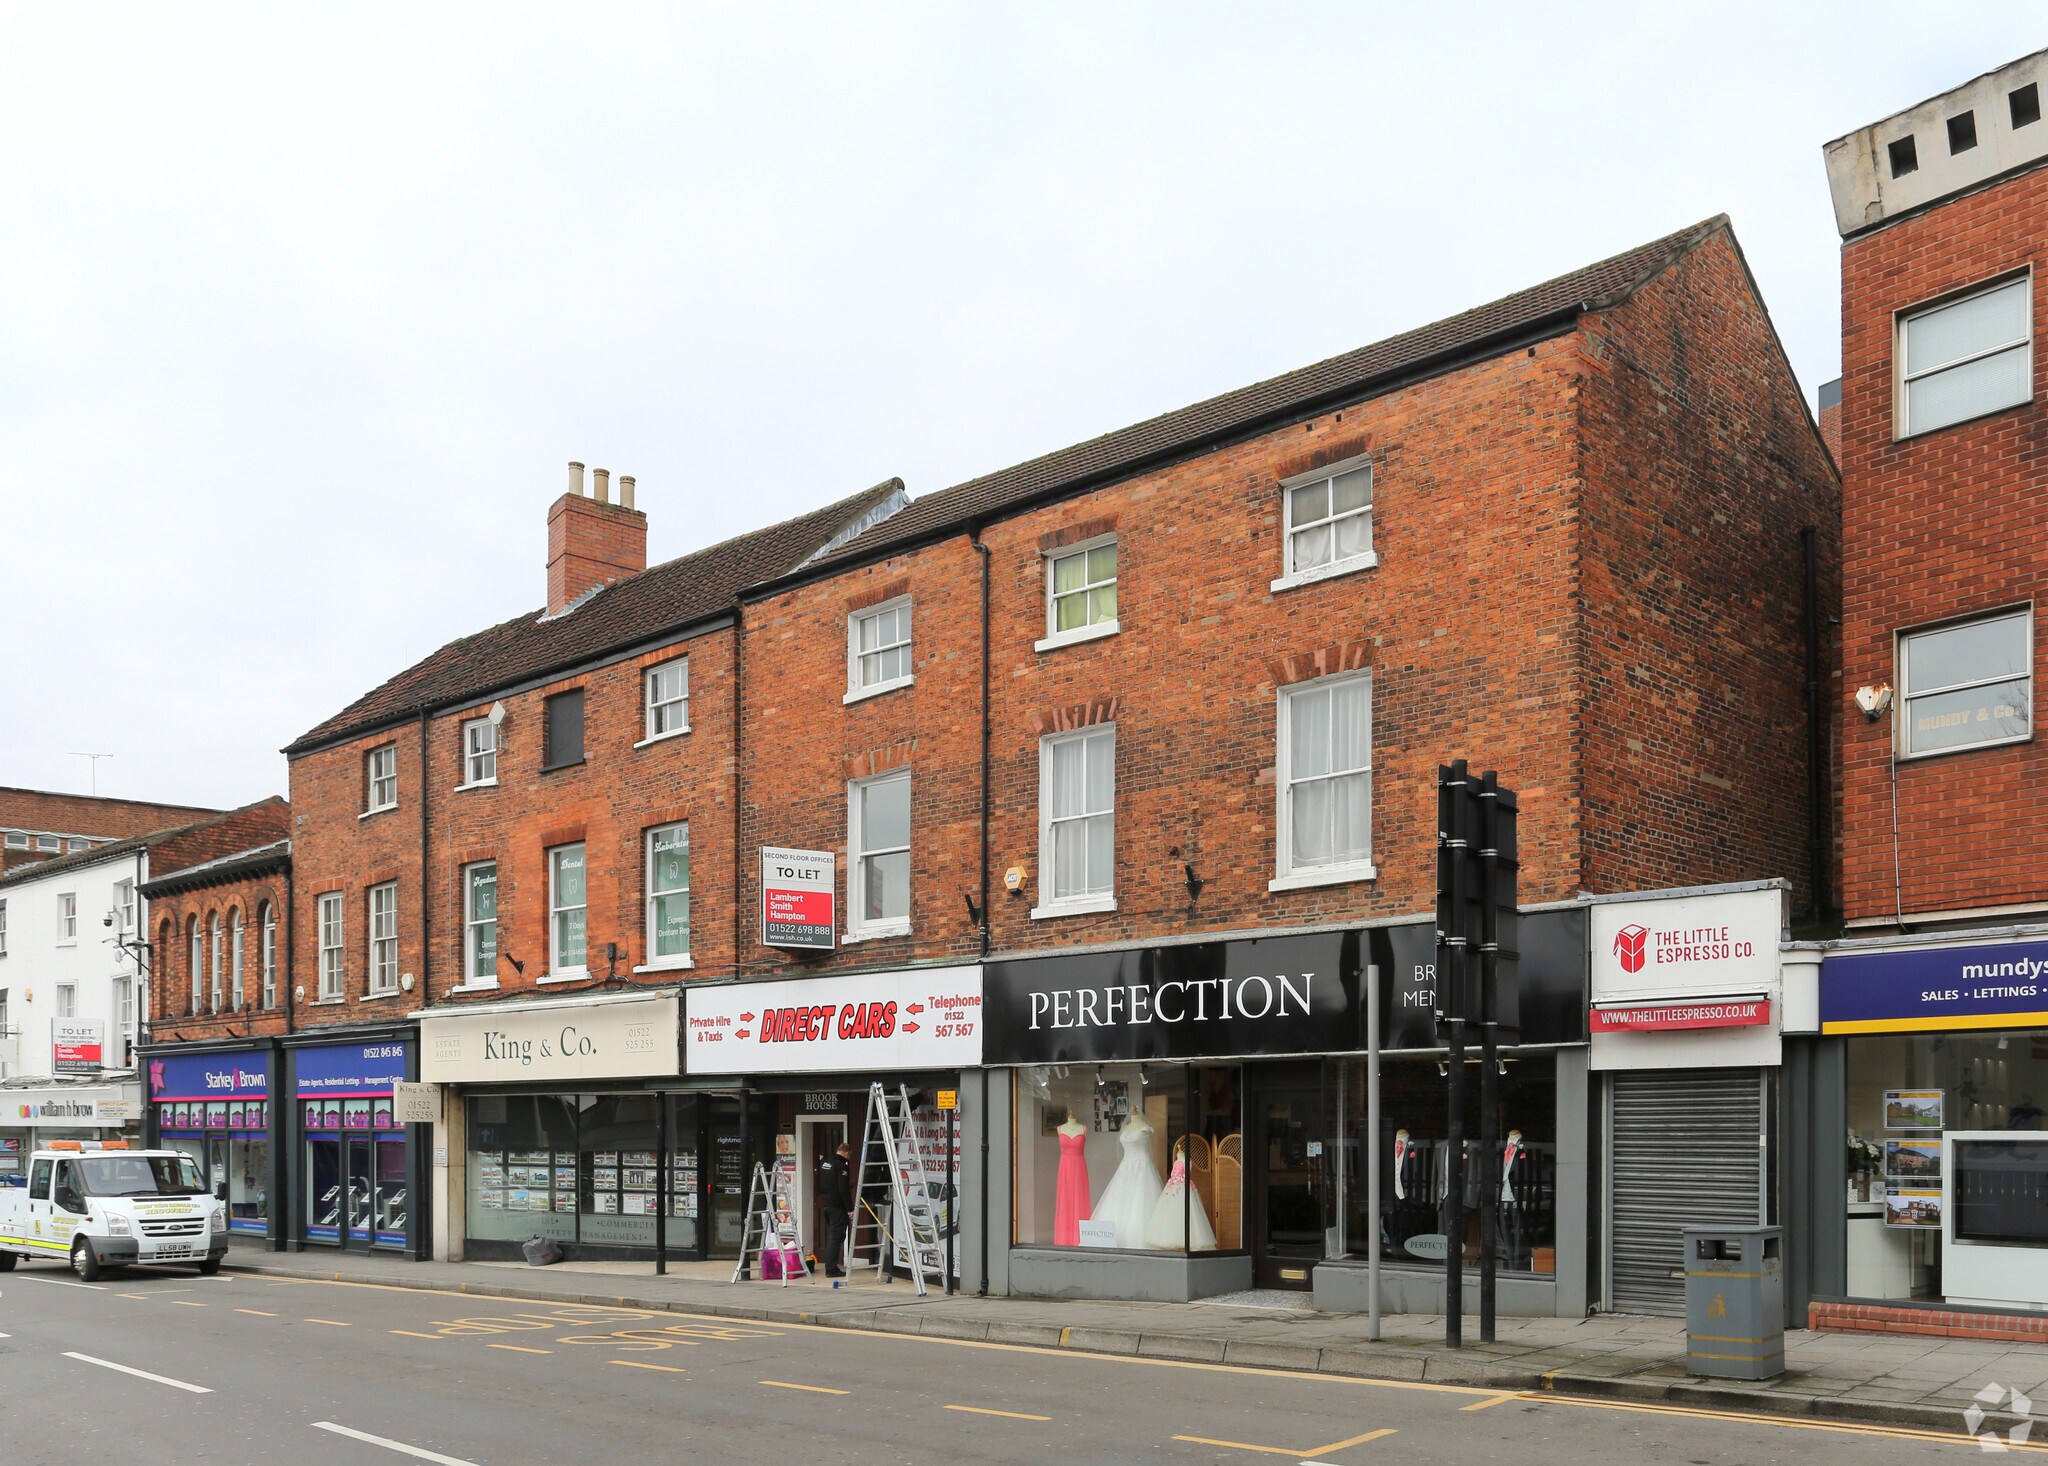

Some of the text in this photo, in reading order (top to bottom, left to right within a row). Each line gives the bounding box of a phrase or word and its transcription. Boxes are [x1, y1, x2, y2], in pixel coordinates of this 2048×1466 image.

[1919, 711, 1970, 731] MUNDY
[1977, 707, 1988, 721] &
[764, 852, 788, 860] SECOND
[789, 854, 809, 862] FLOOR
[776, 866, 820, 880] TO LET
[770, 892, 804, 902] Lambert
[770, 901, 793, 911] Smith
[667, 916, 687, 924] Express
[770, 911, 806, 921] Hampton
[680, 927, 690, 936] Rep
[769, 923, 830, 936] 01522 698 888
[769, 934, 813, 942] www.lsh.co.uk
[1654, 926, 1729, 946] THE LITTLE
[1656, 941, 1756, 964] ESPRESSO CO.
[1921, 985, 2037, 1002] SALES LETTINGS
[929, 994, 981, 1010] Telephone
[1028, 972, 1315, 1030] PERFECTION
[944, 1011, 965, 1021] 01522
[1601, 1004, 1757, 1024] WWW.THELITTLEESPRESSO.CO.UK
[690, 1015, 731, 1028] Private Hire
[760, 1001, 897, 1043] DIRECT CARS
[628, 1027, 650, 1037] 01522
[935, 1022, 974, 1038] 567 567
[697, 1030, 723, 1042] & Taxis
[435, 1040, 461, 1048] ESTATE
[483, 1026, 597, 1065] King & Co.
[625, 1039, 654, 1049] 525 255
[363, 1046, 402, 1058] 01522 845 845
[435, 1050, 461, 1058] AGENTS
[399, 1085, 417, 1094] King
[804, 1093, 838, 1102] BROOK
[72, 1100, 93, 1117] brow
[407, 1101, 430, 1109] 01522
[806, 1101, 838, 1110] HOUSE
[406, 1111, 434, 1119] 525255
[600, 1220, 655, 1229] COMMERCIA
[1081, 1230, 1115, 1238] PERFECTION
[1410, 1241, 1447, 1249] PERFECTI
